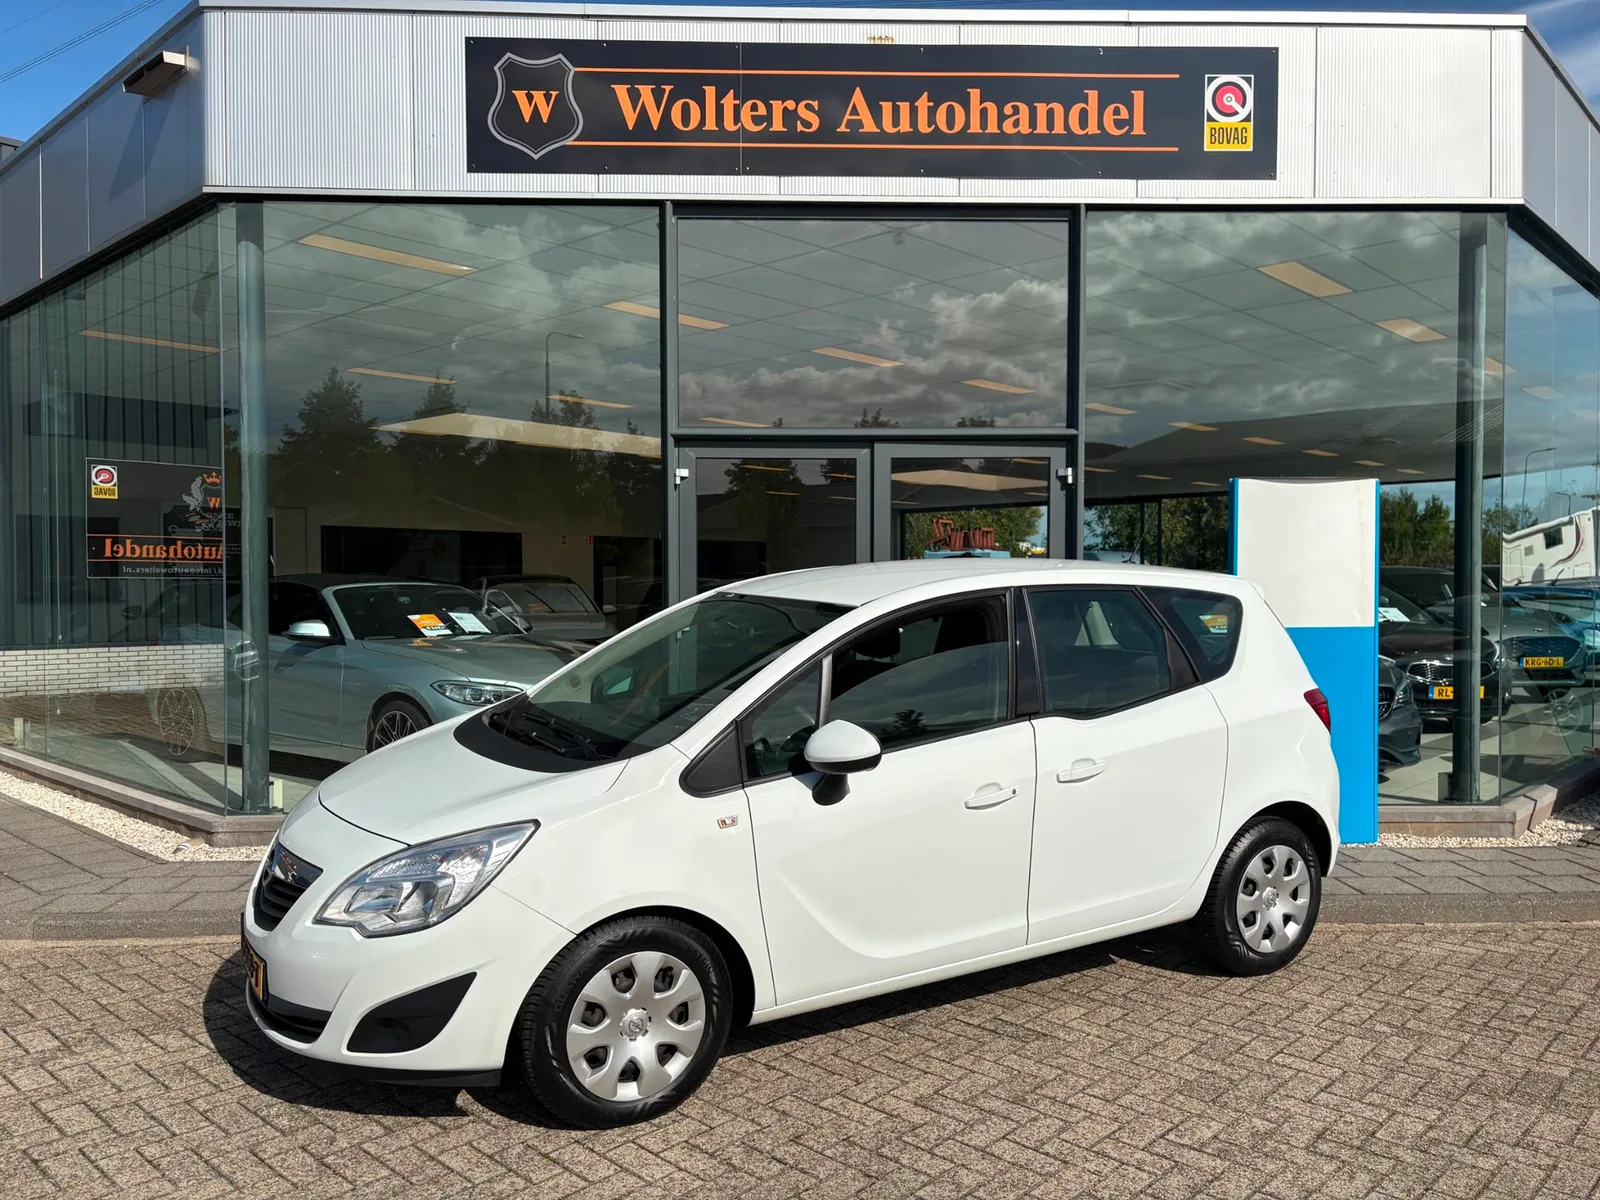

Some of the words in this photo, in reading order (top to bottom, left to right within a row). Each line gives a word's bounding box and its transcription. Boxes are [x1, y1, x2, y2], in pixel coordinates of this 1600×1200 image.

[511, 90, 559, 124] W
[610, 84, 820, 133] Wolters
[836, 87, 1147, 137] Autohandel
[1209, 127, 1248, 145] BOVAG
